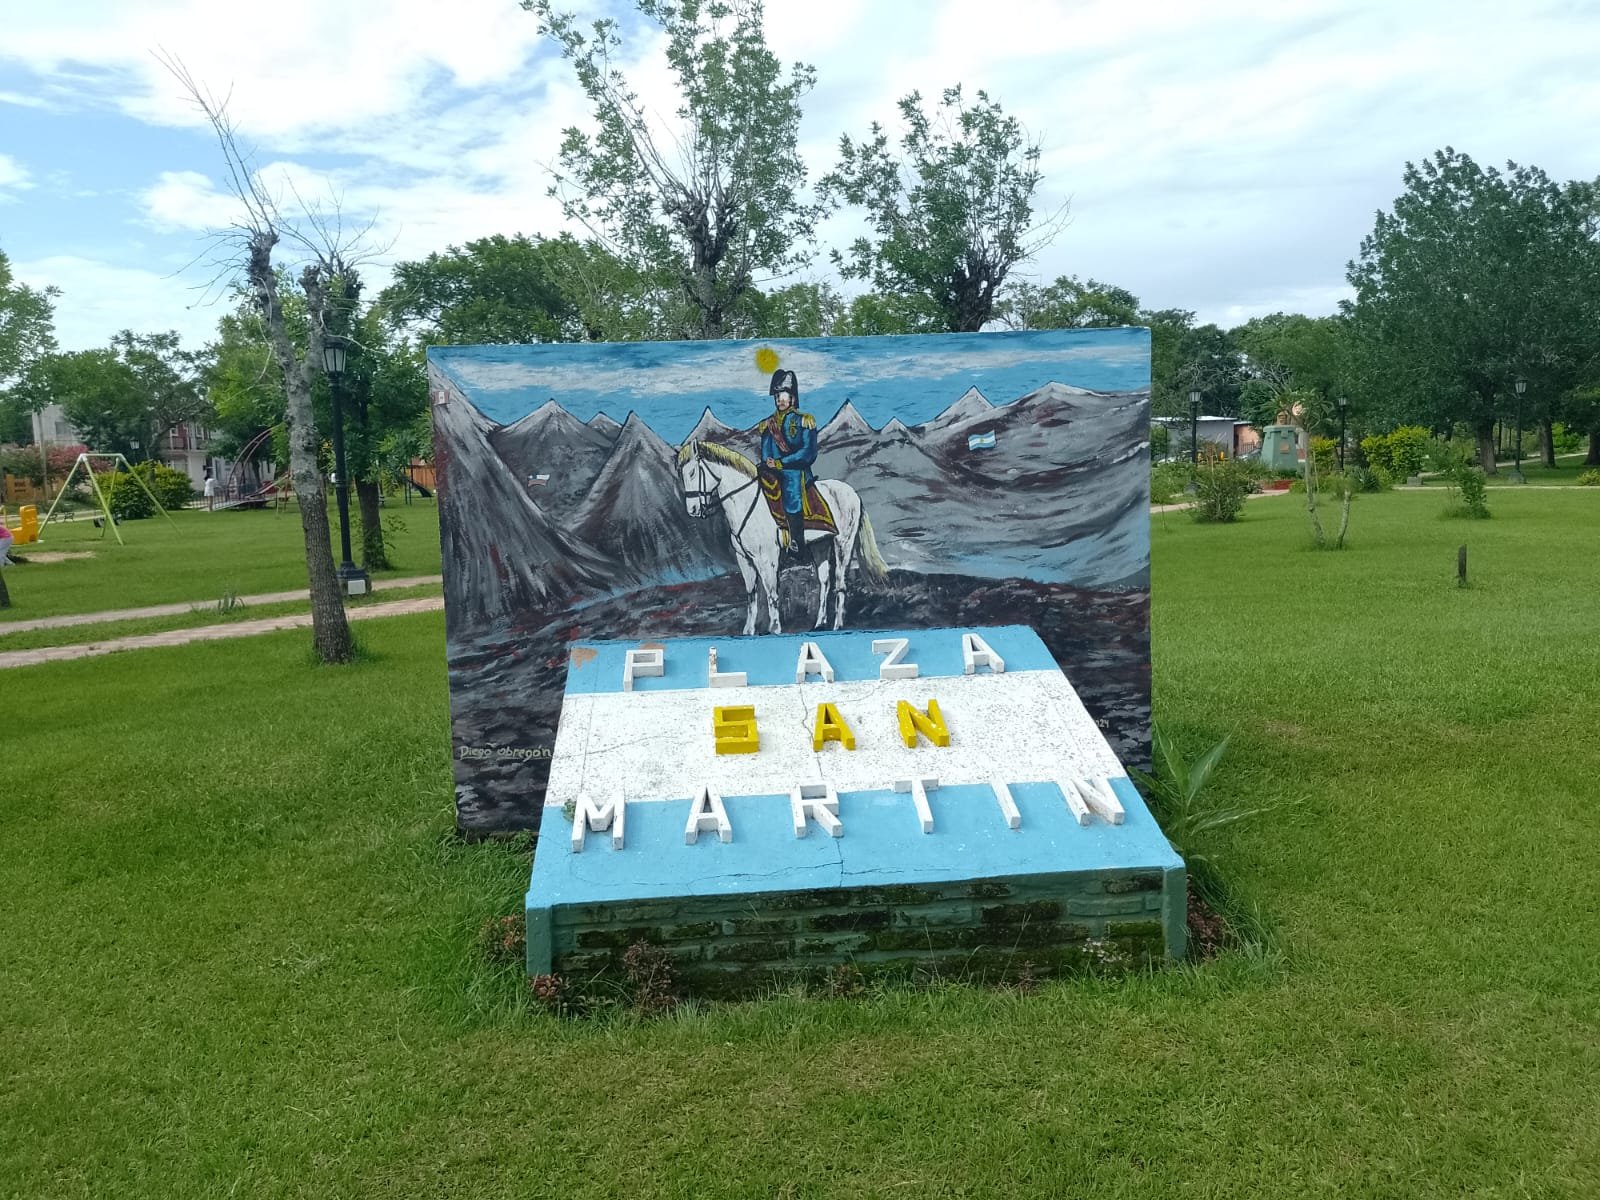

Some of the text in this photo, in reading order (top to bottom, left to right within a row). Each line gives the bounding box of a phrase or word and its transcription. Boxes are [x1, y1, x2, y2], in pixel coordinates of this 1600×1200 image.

[623, 633, 1005, 692] PLAZA
[460, 745, 492, 760] Diego
[712, 699, 951, 755] SAN
[571, 777, 1125, 853] MARTIN
